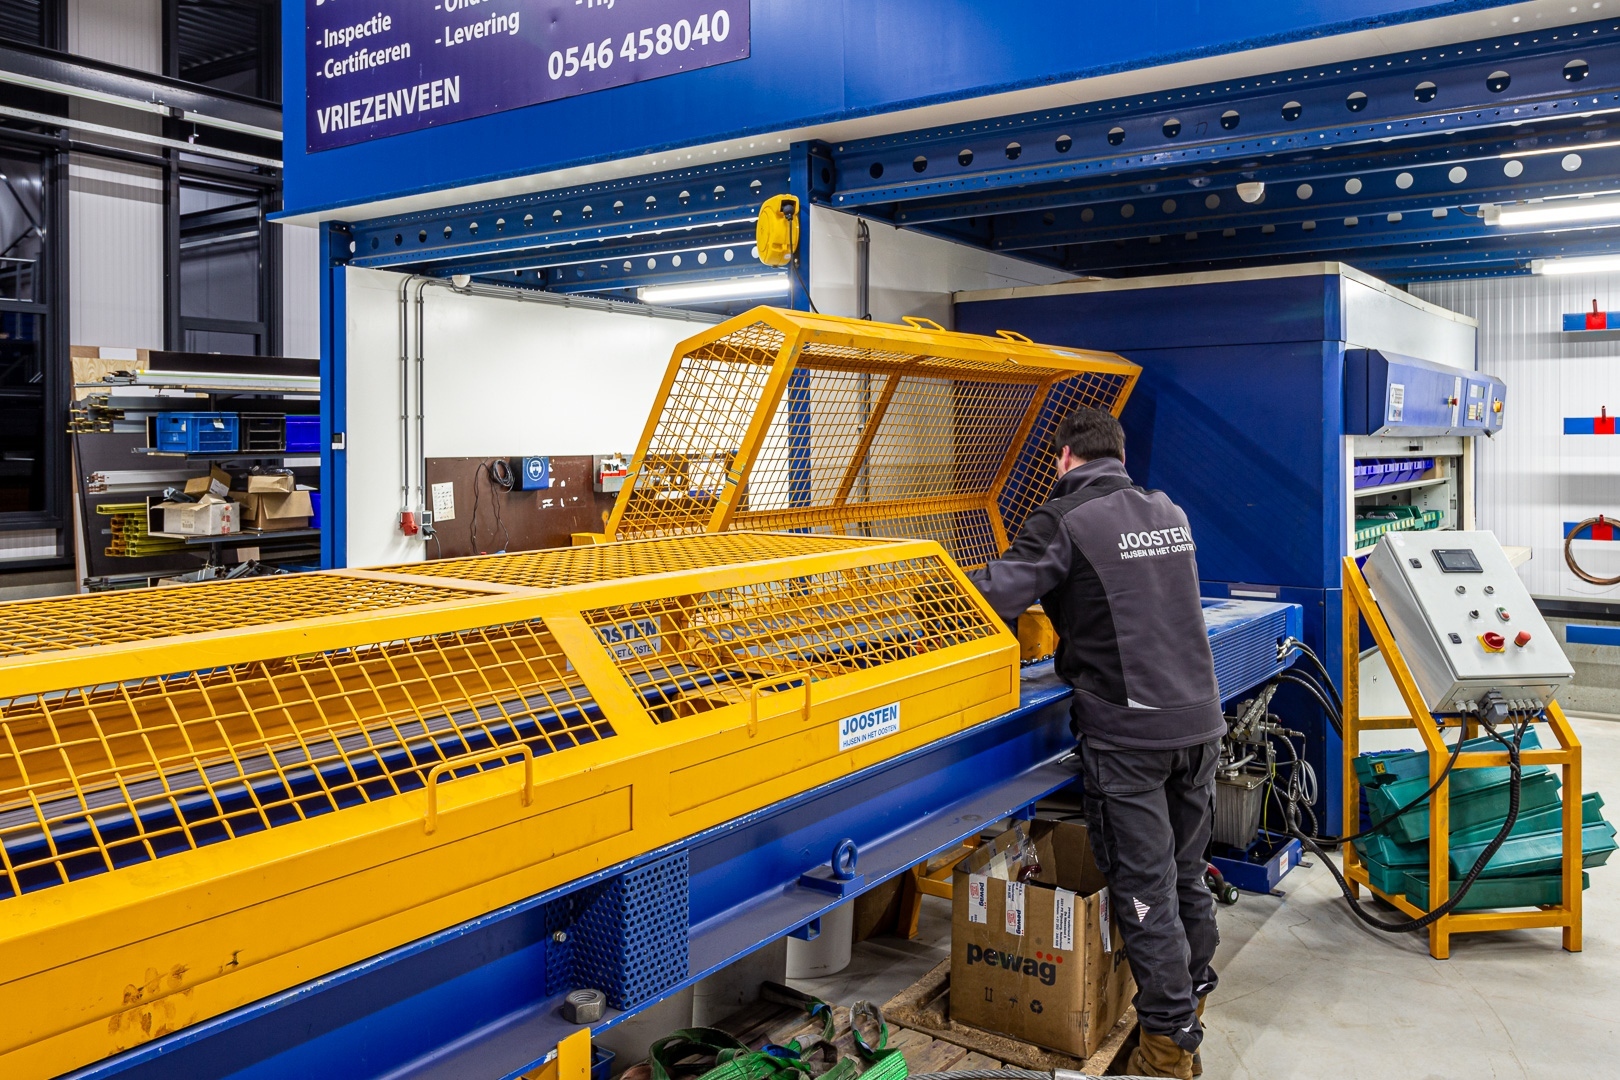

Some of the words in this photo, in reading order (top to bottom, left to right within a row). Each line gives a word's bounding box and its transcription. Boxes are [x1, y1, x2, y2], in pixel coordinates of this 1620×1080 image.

[325, 12, 391, 48] Inspectie
[446, 12, 520, 47] Levering
[548, 38, 614, 80] 0546
[620, 10, 731, 63] 458040
[325, 43, 411, 79] Certificeren
[317, 75, 460, 134] VRIEZENVEEN
[1118, 526, 1191, 549] JOOSTEN
[1120, 548, 1147, 560] HIJSEN
[1148, 547, 1156, 556] IN
[1157, 546, 1170, 555] HET
[842, 705, 898, 736] JOOSTEN
[843, 736, 861, 748] HIJSEN
[868, 731, 877, 739] HET
[878, 724, 897, 736] OOSTEN
[966, 943, 1057, 986] pewag
